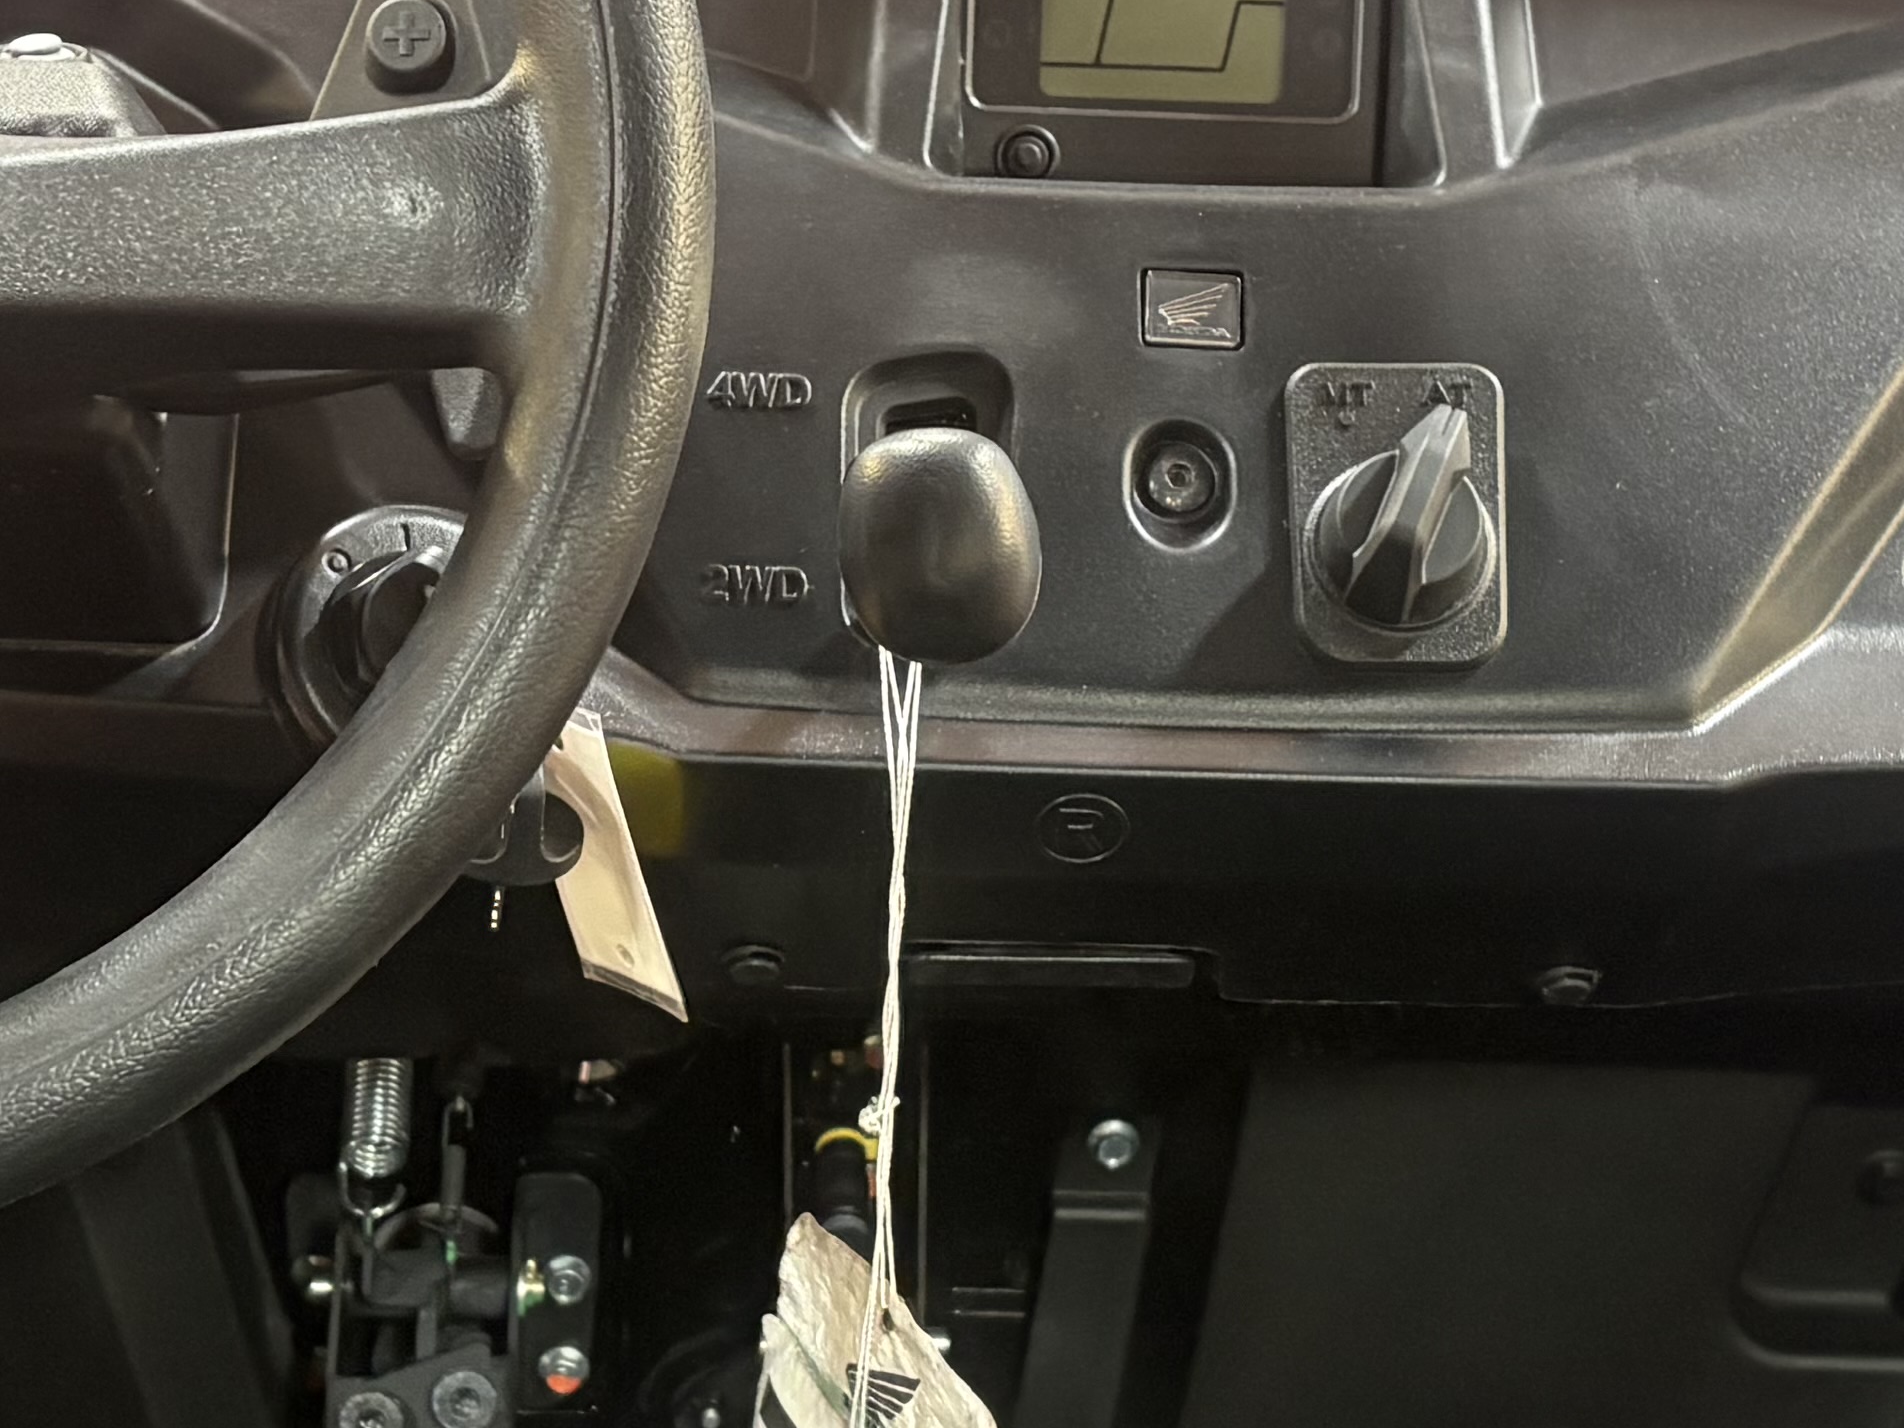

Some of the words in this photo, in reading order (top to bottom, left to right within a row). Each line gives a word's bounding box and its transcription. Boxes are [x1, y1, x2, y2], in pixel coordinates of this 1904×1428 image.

[705, 371, 813, 409] 4WD
[1318, 379, 1376, 408] MT
[1420, 376, 1473, 410] AT
[702, 563, 810, 603] 2WD
